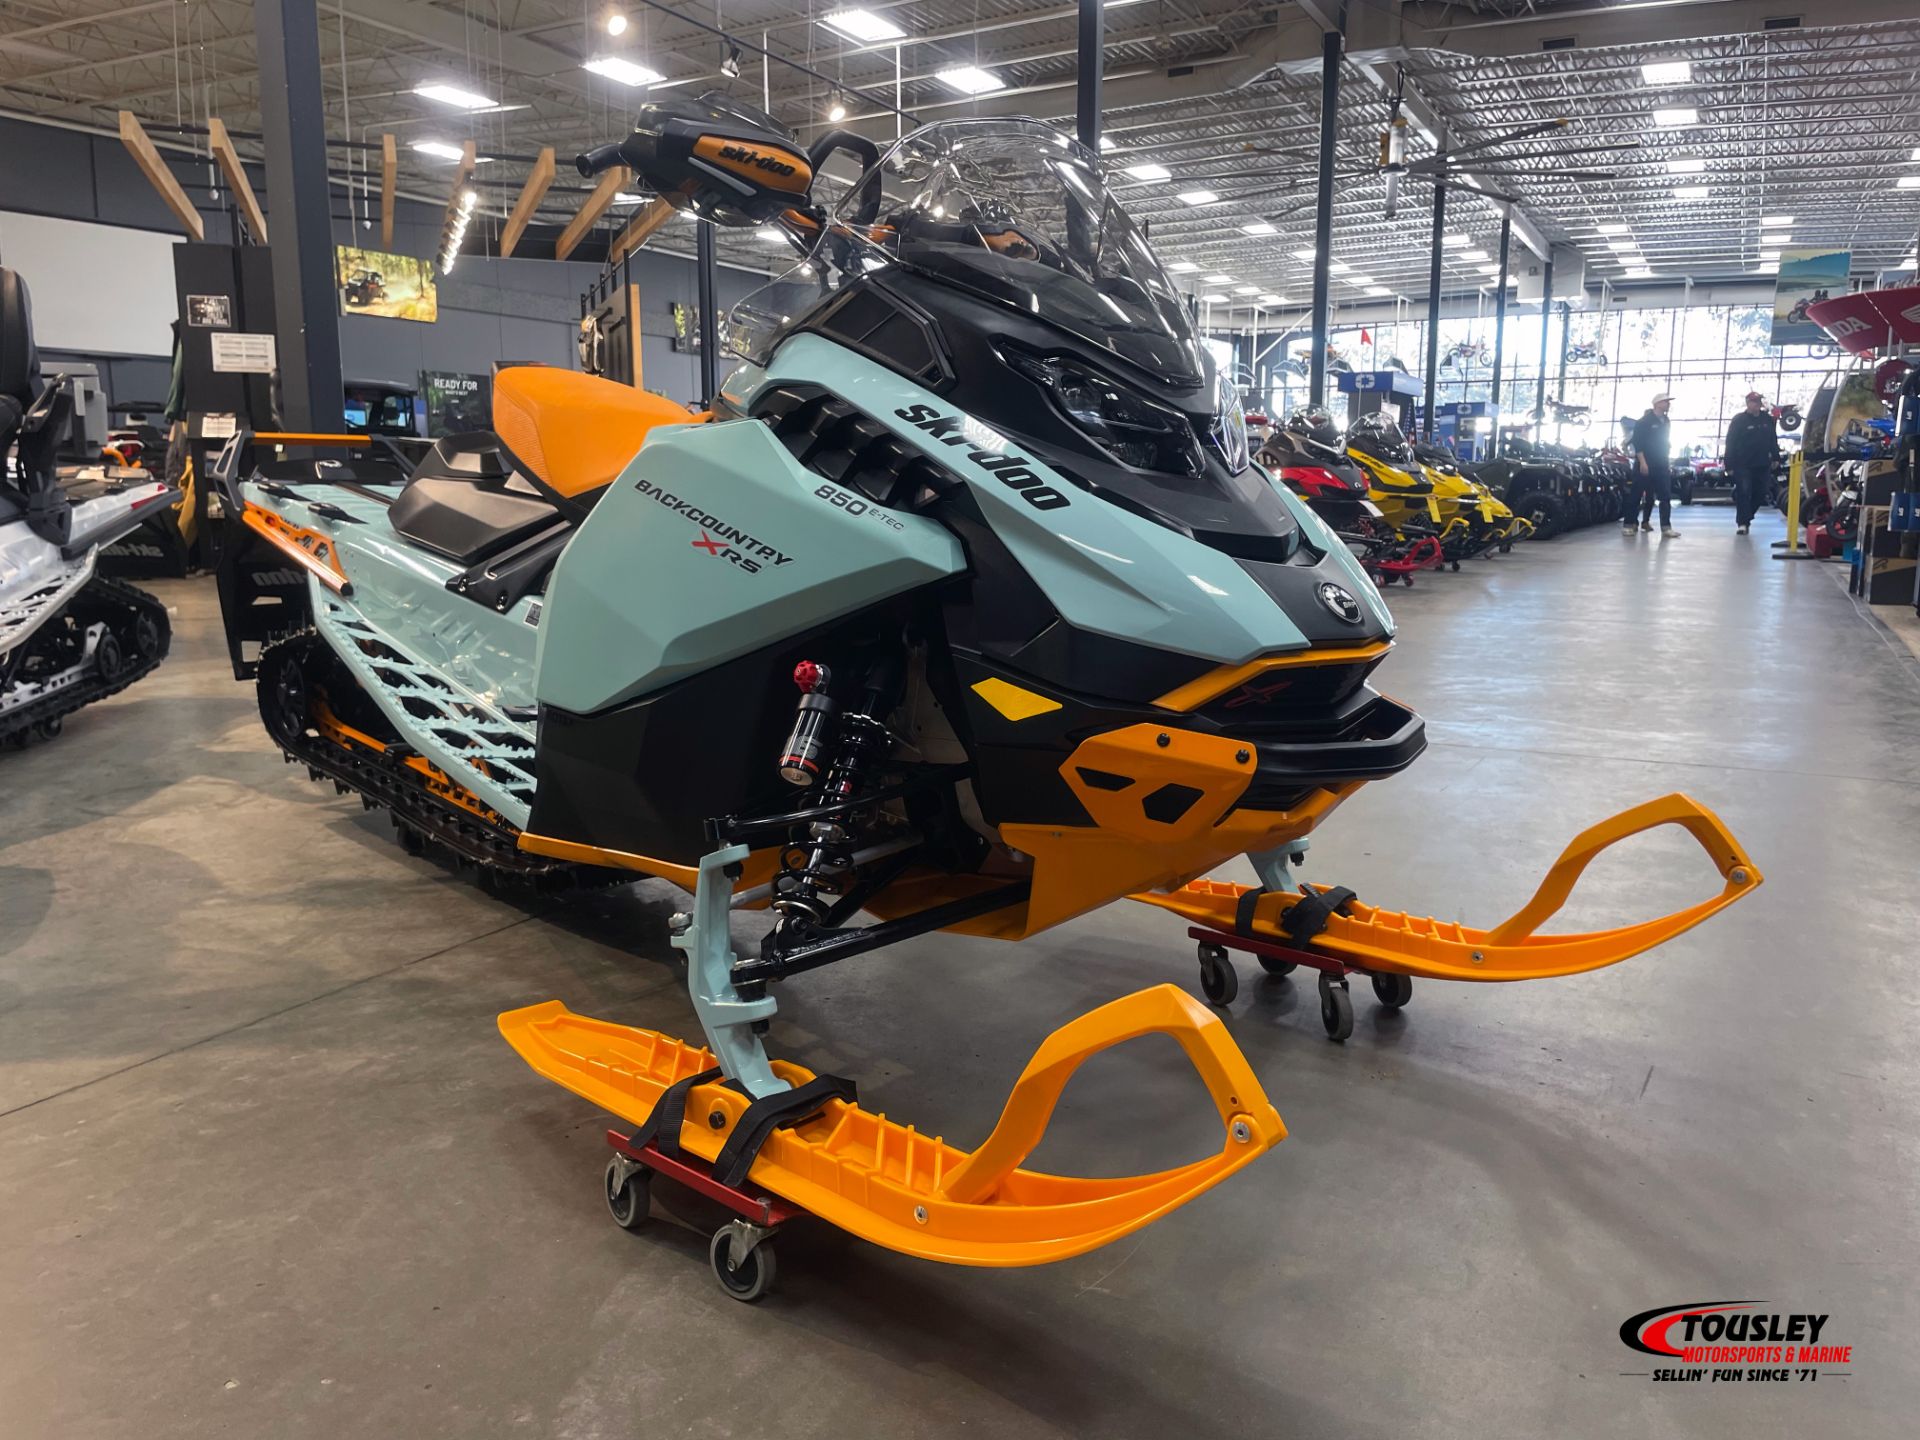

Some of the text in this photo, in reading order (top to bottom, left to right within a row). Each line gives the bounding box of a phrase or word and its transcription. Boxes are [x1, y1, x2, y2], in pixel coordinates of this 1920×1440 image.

[718, 146, 796, 177] ski-doo
[434, 379, 478, 390] READY FOR
[634, 479, 794, 567] BACKCOUNTRY
[814, 484, 905, 531] 850 E-TEC
